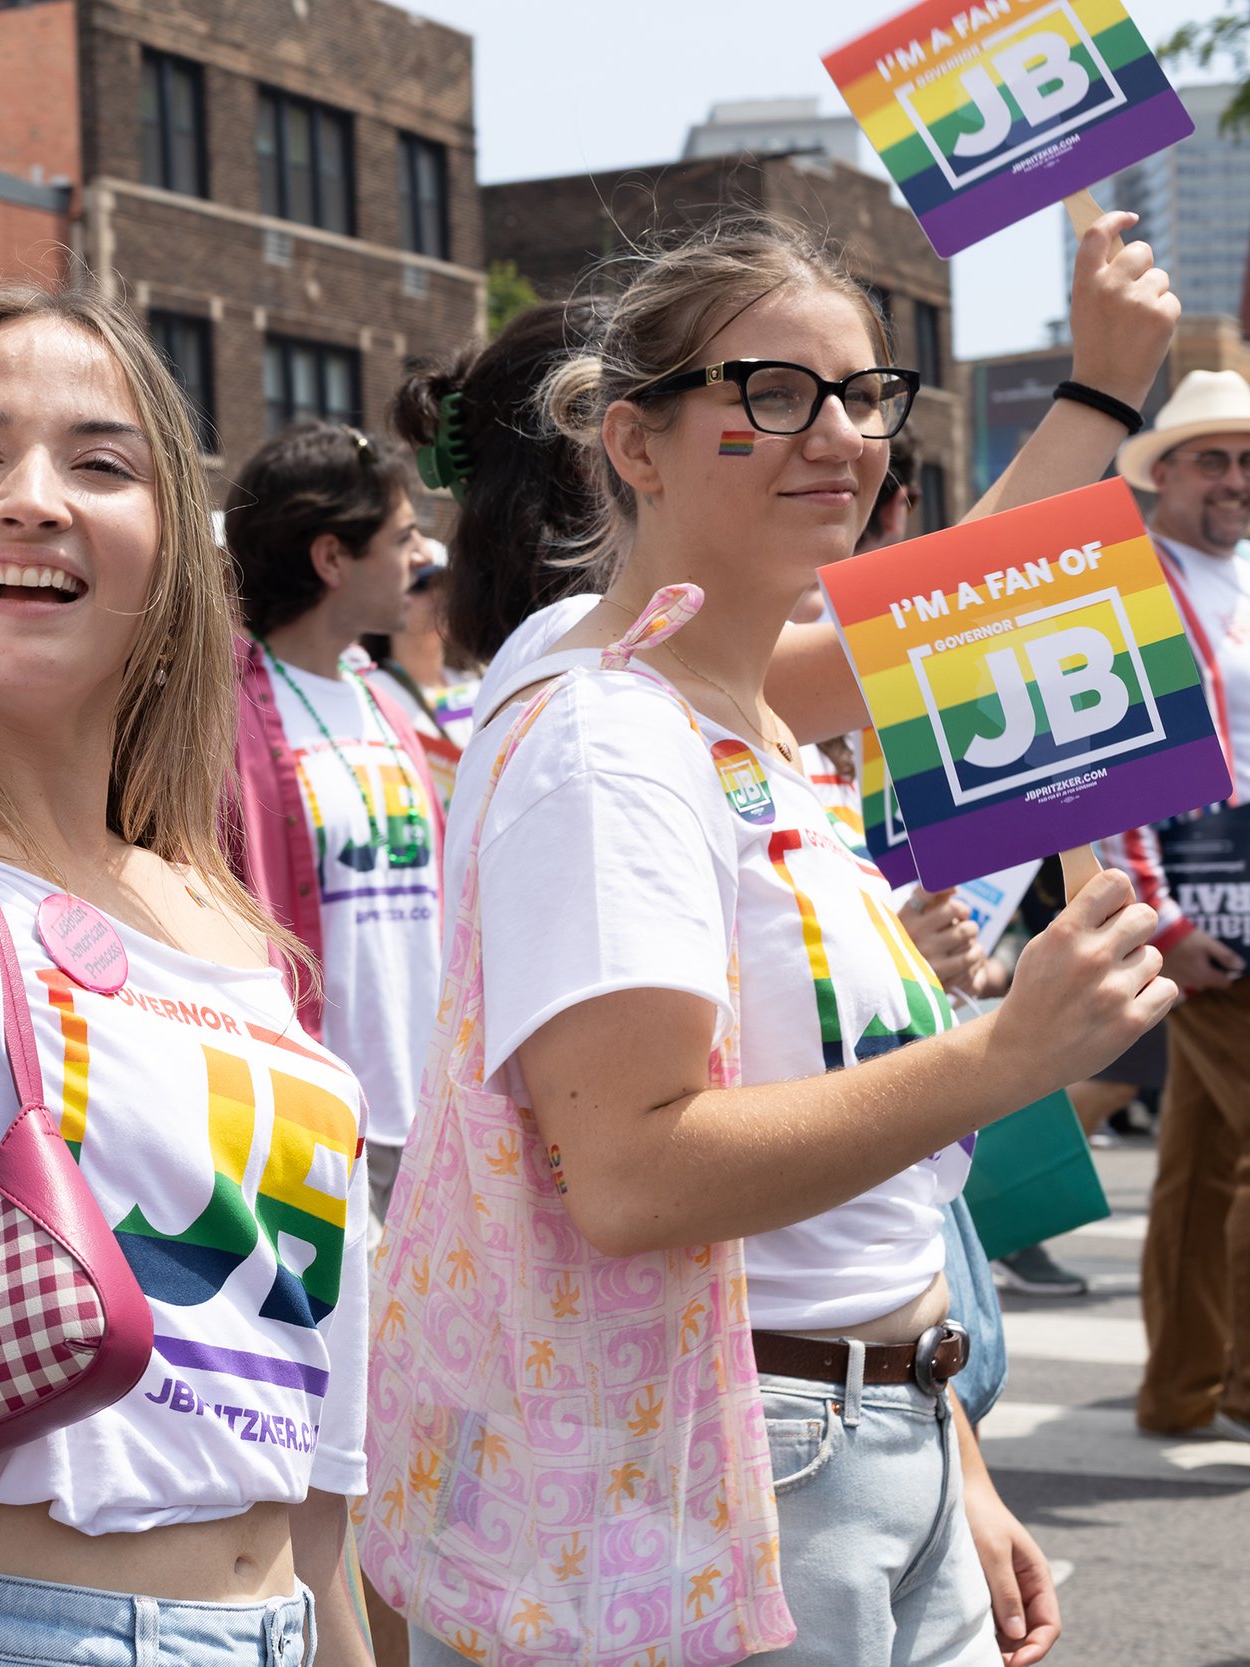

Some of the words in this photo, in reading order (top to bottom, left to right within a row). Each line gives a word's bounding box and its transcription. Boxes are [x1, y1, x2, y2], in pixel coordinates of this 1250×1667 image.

[875, 40, 927, 82] I'M
[931, 27, 954, 56] A
[951, 0, 1012, 40] FAN
[916, 44, 980, 89] GOVERNOR
[953, 31, 1090, 158] JB
[1012, 133, 1081, 174] JBPRITZKER.COM
[889, 588, 951, 630] I'M
[957, 581, 985, 611] A
[983, 556, 1055, 600] FAN
[1058, 540, 1103, 576] OF
[934, 619, 1014, 653] GOVERNOR
[963, 626, 1130, 769] JB
[732, 769, 761, 805] JB
[1024, 767, 1108, 802] JBPRITZKER.COM
[337, 764, 431, 873] JB
[51, 905, 88, 940] Lesbian
[65, 920, 108, 962] American
[84, 941, 123, 980] Princess
[100, 987, 242, 1037] OVERNOR
[112, 1044, 359, 1330] JB
